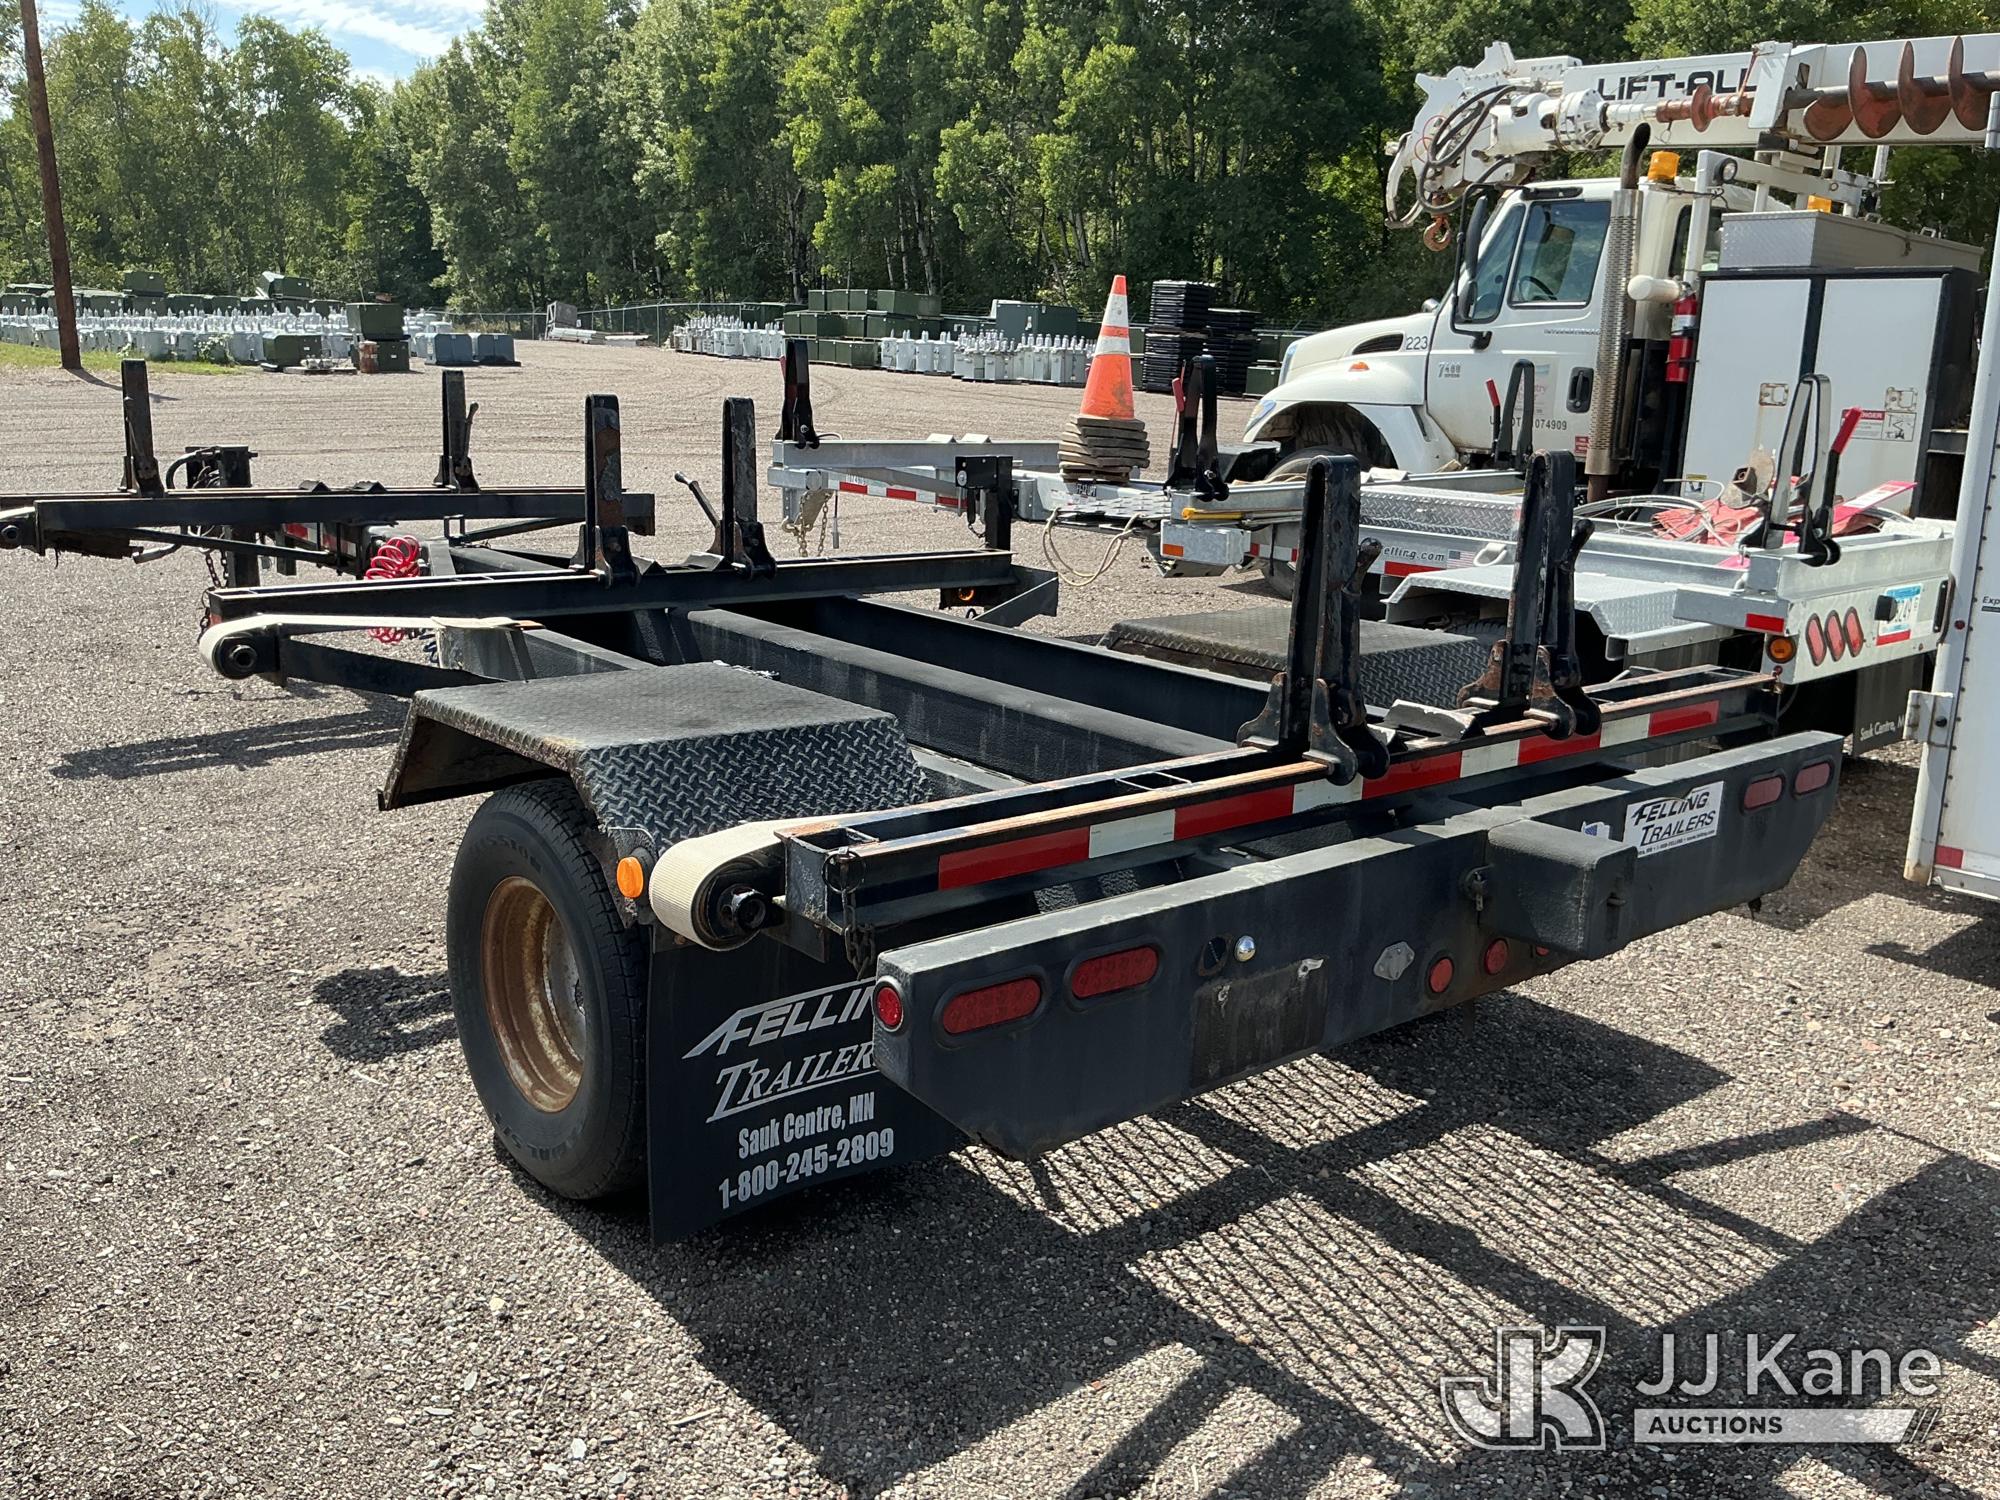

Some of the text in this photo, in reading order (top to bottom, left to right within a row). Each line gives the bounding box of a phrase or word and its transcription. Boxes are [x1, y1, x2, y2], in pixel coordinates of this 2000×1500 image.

[1598, 68, 1757, 101] LIFT-ALL
[1406, 336, 1428, 350] 223
[1535, 418, 1567, 431] 074909
[1384, 547, 1445, 561] elling.com
[1897, 714, 1905, 729] M
[1631, 792, 1709, 826] FELLING
[682, 977, 875, 1059] FELLIN
[706, 1040, 879, 1123] TRAILER
[738, 1091, 875, 1159] Sauk Centre, MN
[718, 1127, 894, 1209] 1-800-245-2809
